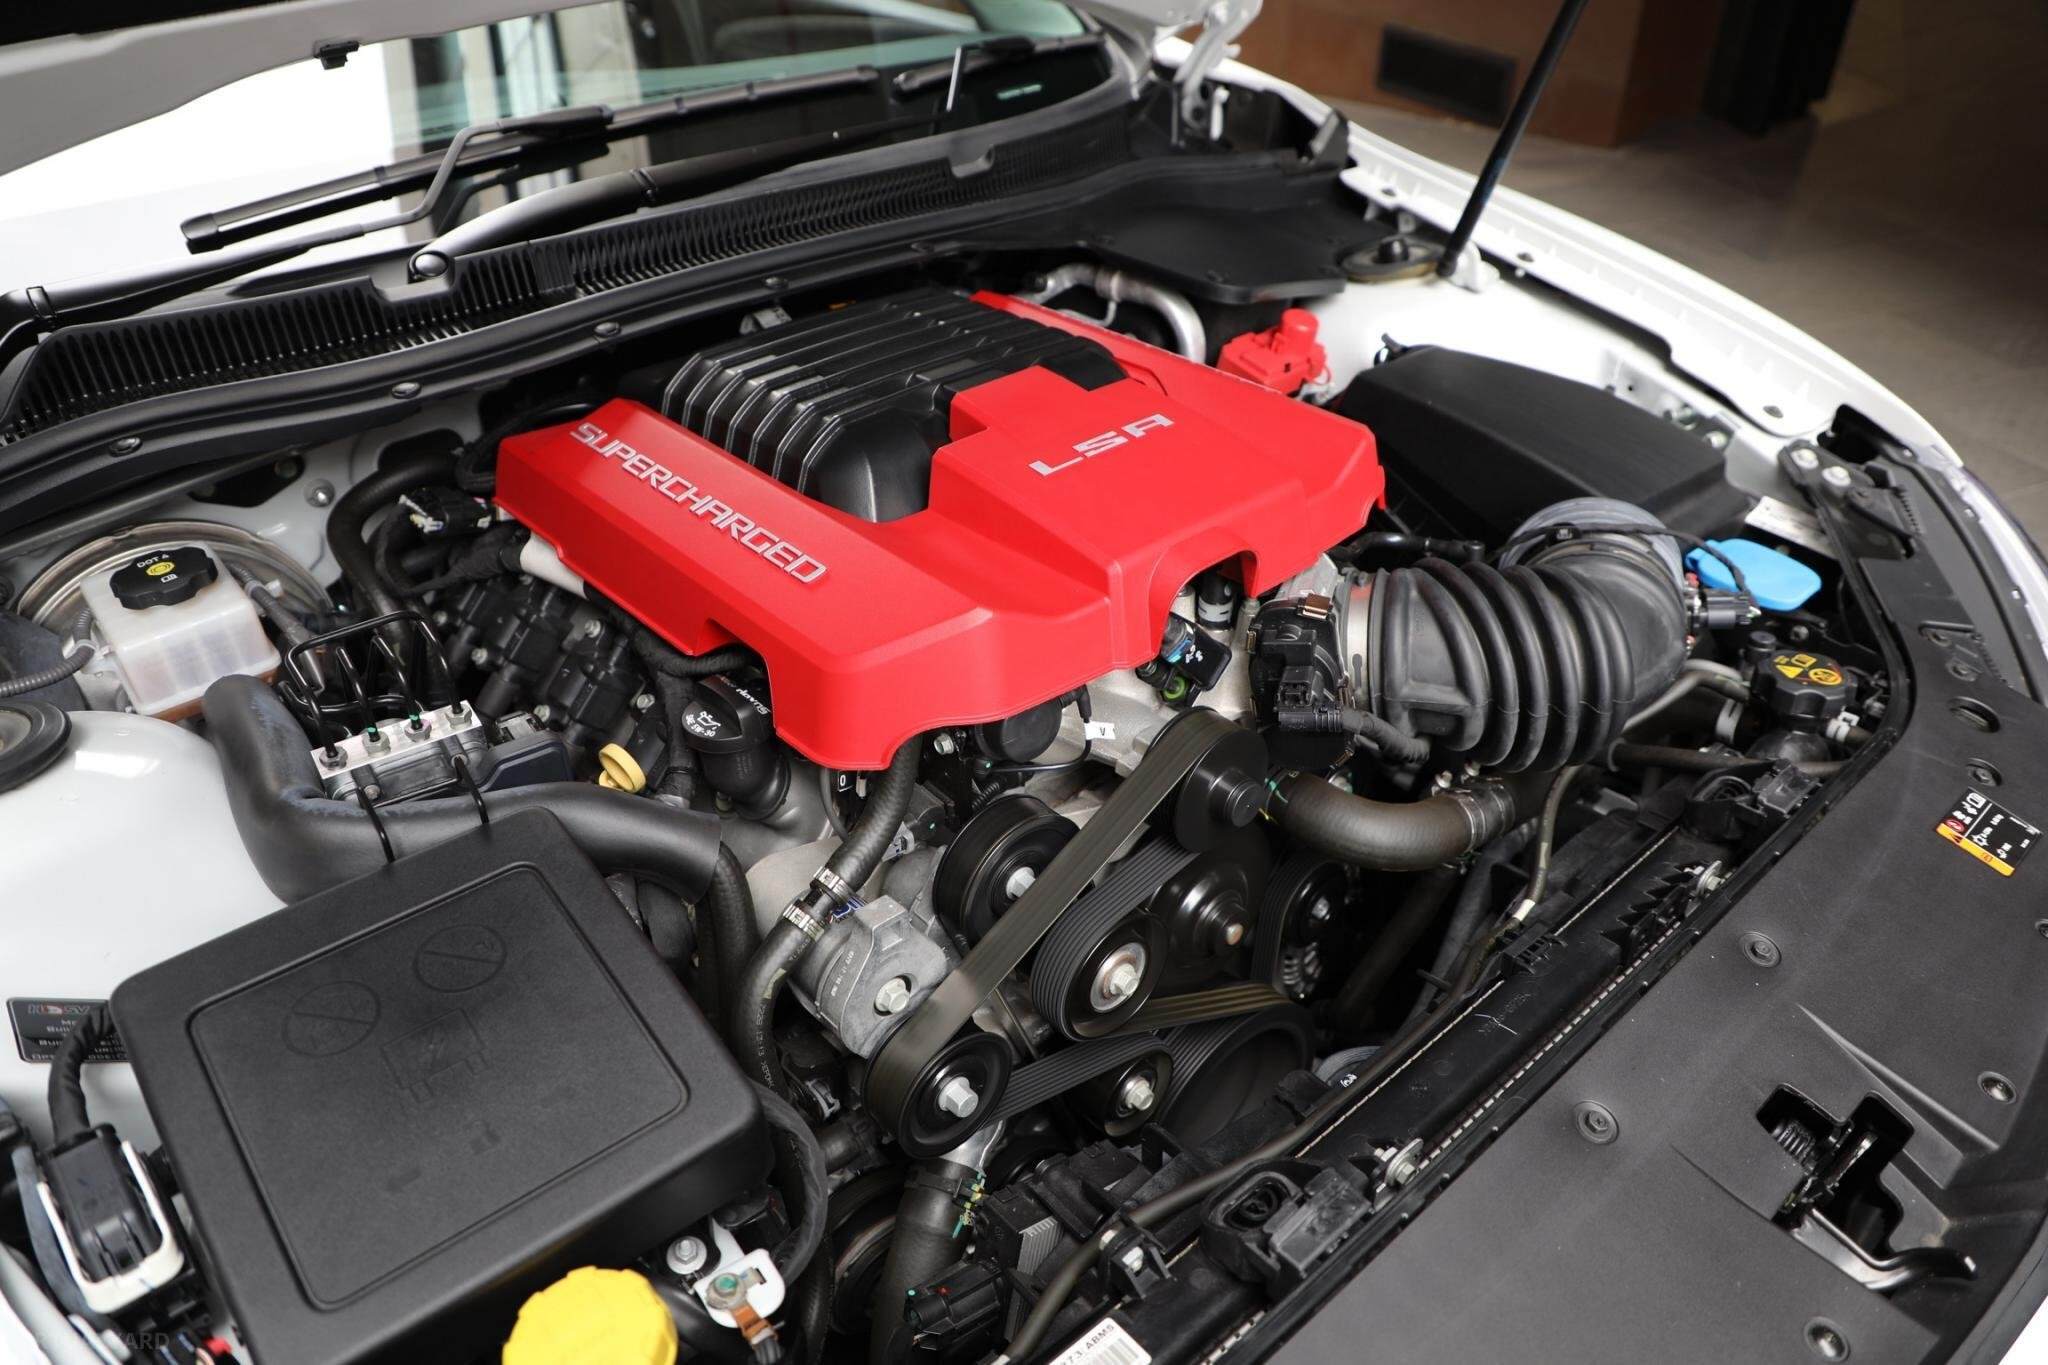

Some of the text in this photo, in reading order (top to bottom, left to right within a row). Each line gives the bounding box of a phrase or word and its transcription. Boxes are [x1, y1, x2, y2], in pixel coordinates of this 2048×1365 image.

[1028, 413, 1175, 477] LSA
[569, 421, 828, 585] SUPERCHARGED
[137, 556, 160, 568] DOT
